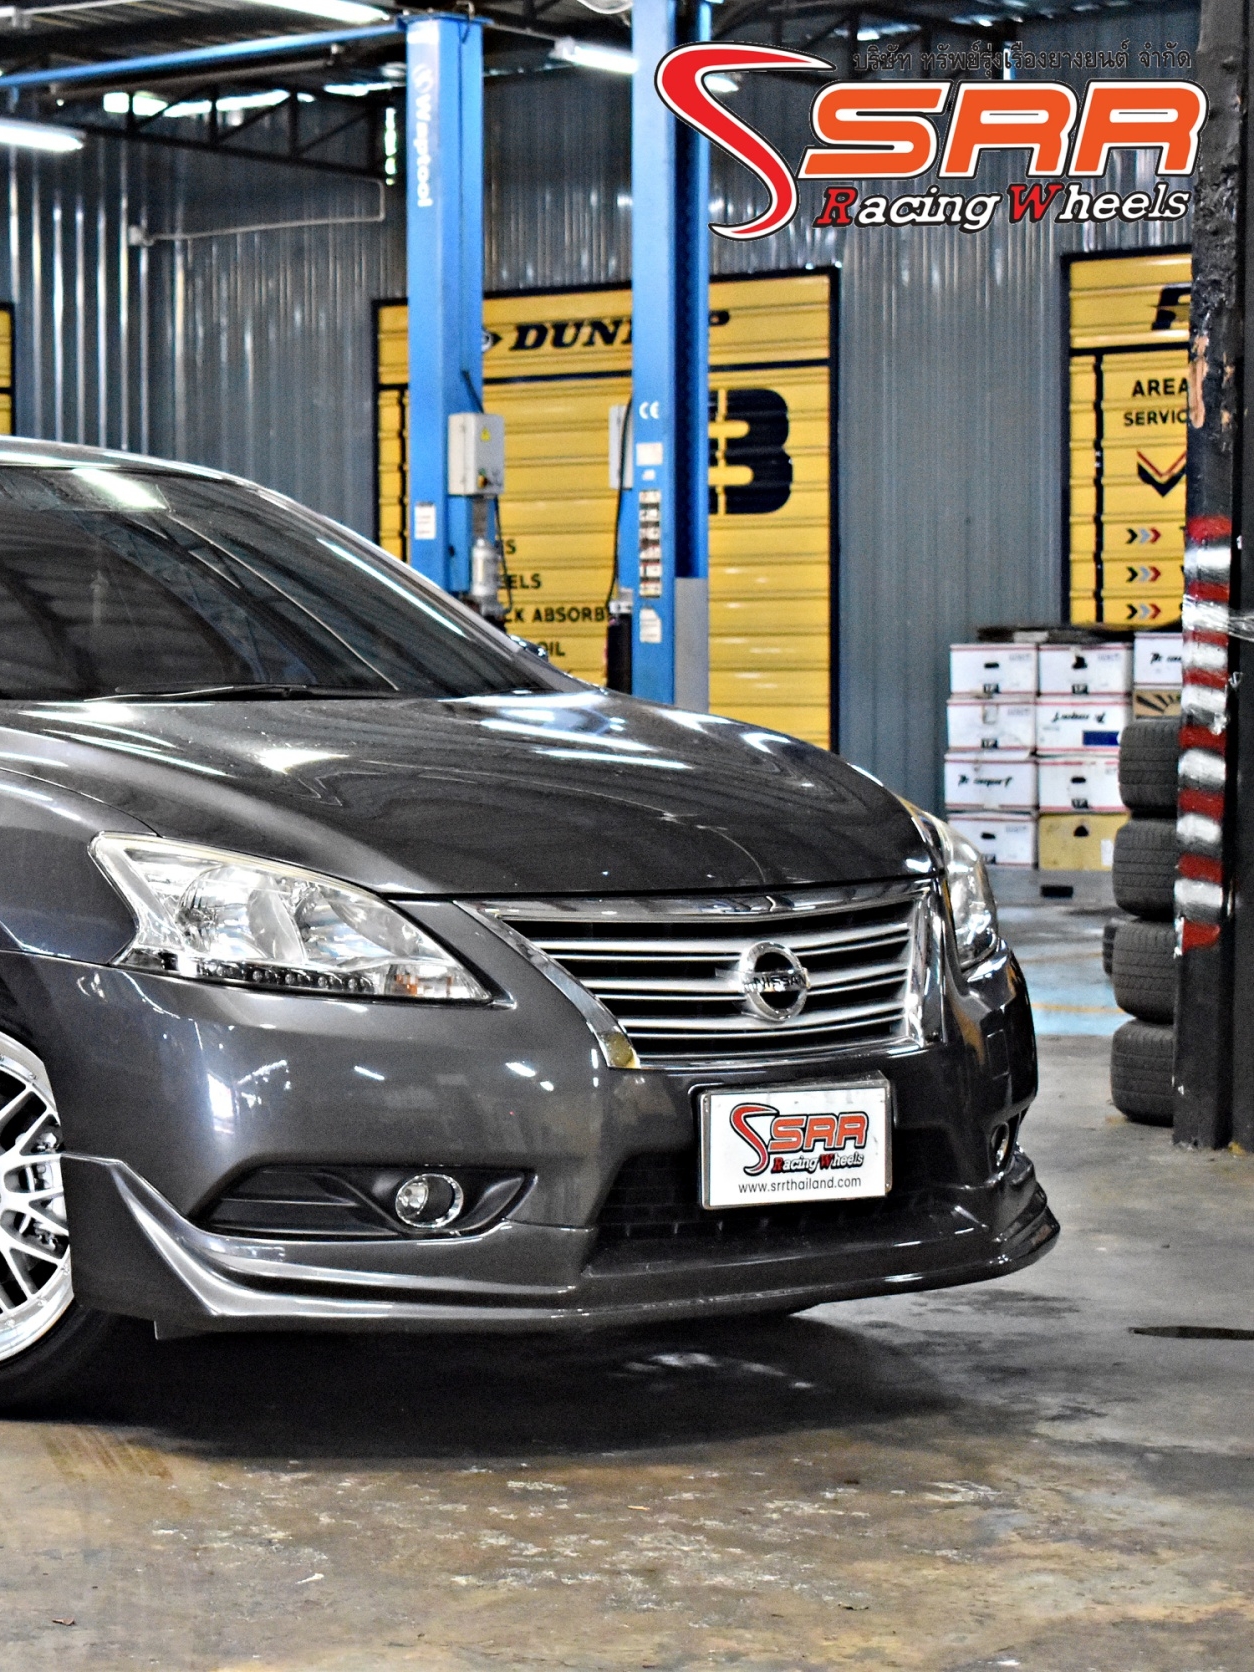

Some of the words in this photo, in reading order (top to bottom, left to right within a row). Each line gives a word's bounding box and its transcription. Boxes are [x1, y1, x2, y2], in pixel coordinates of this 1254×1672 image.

[1132, 378, 1189, 397] AREA
[532, 606, 607, 622] ABSORB
[771, 1155, 819, 1174] Racing
[819, 1151, 864, 1170] Wheels
[738, 1176, 861, 1193] www.srrthailand.com
